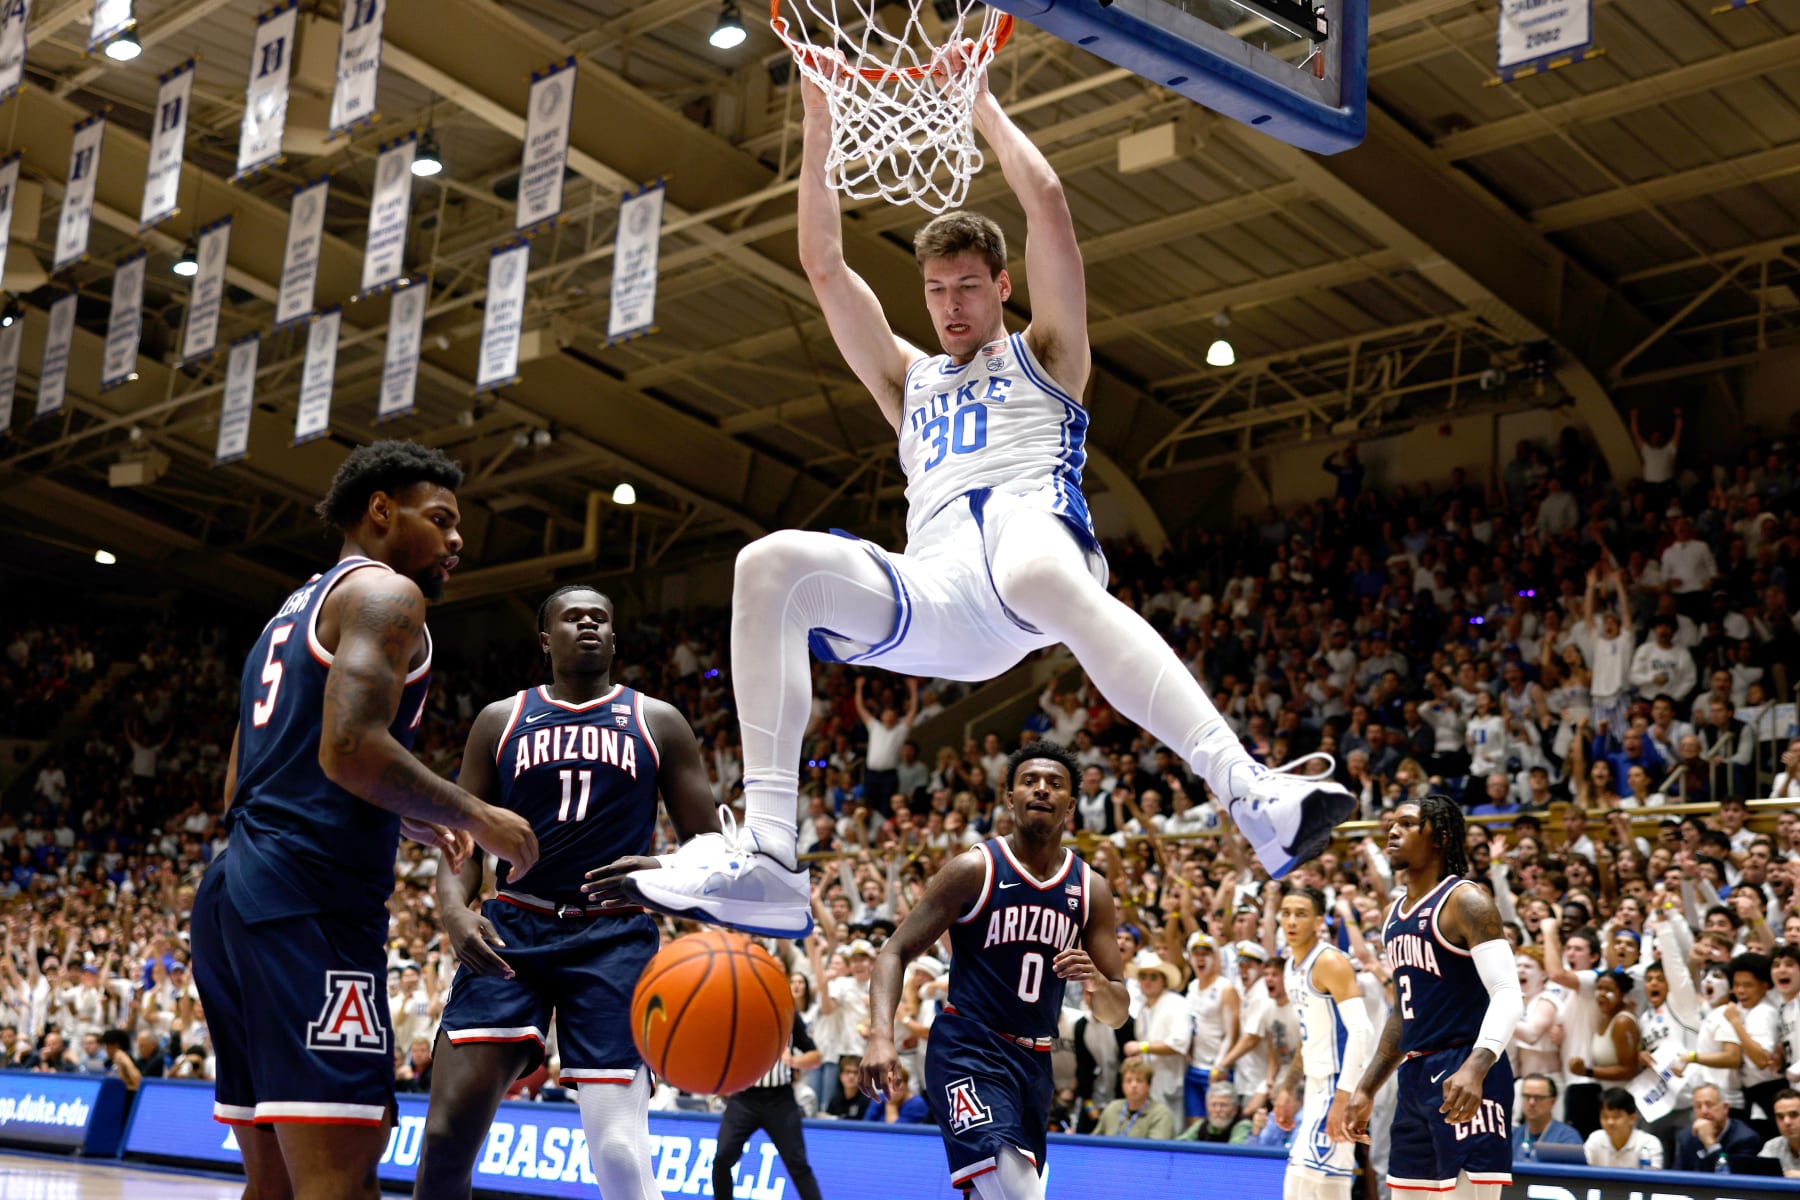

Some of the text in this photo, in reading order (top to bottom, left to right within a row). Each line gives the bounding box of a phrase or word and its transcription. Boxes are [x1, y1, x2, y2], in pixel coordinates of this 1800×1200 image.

[1526, 26, 1561, 50] 2002
[922, 402, 988, 472] 30
[253, 622, 296, 728] 5
[514, 725, 637, 782] ARIZONA
[557, 769, 592, 822] 11
[1018, 952, 1044, 1003] 0
[1399, 974, 1415, 1020] 2
[306, 970, 387, 1055] A
[945, 1076, 993, 1136] A
